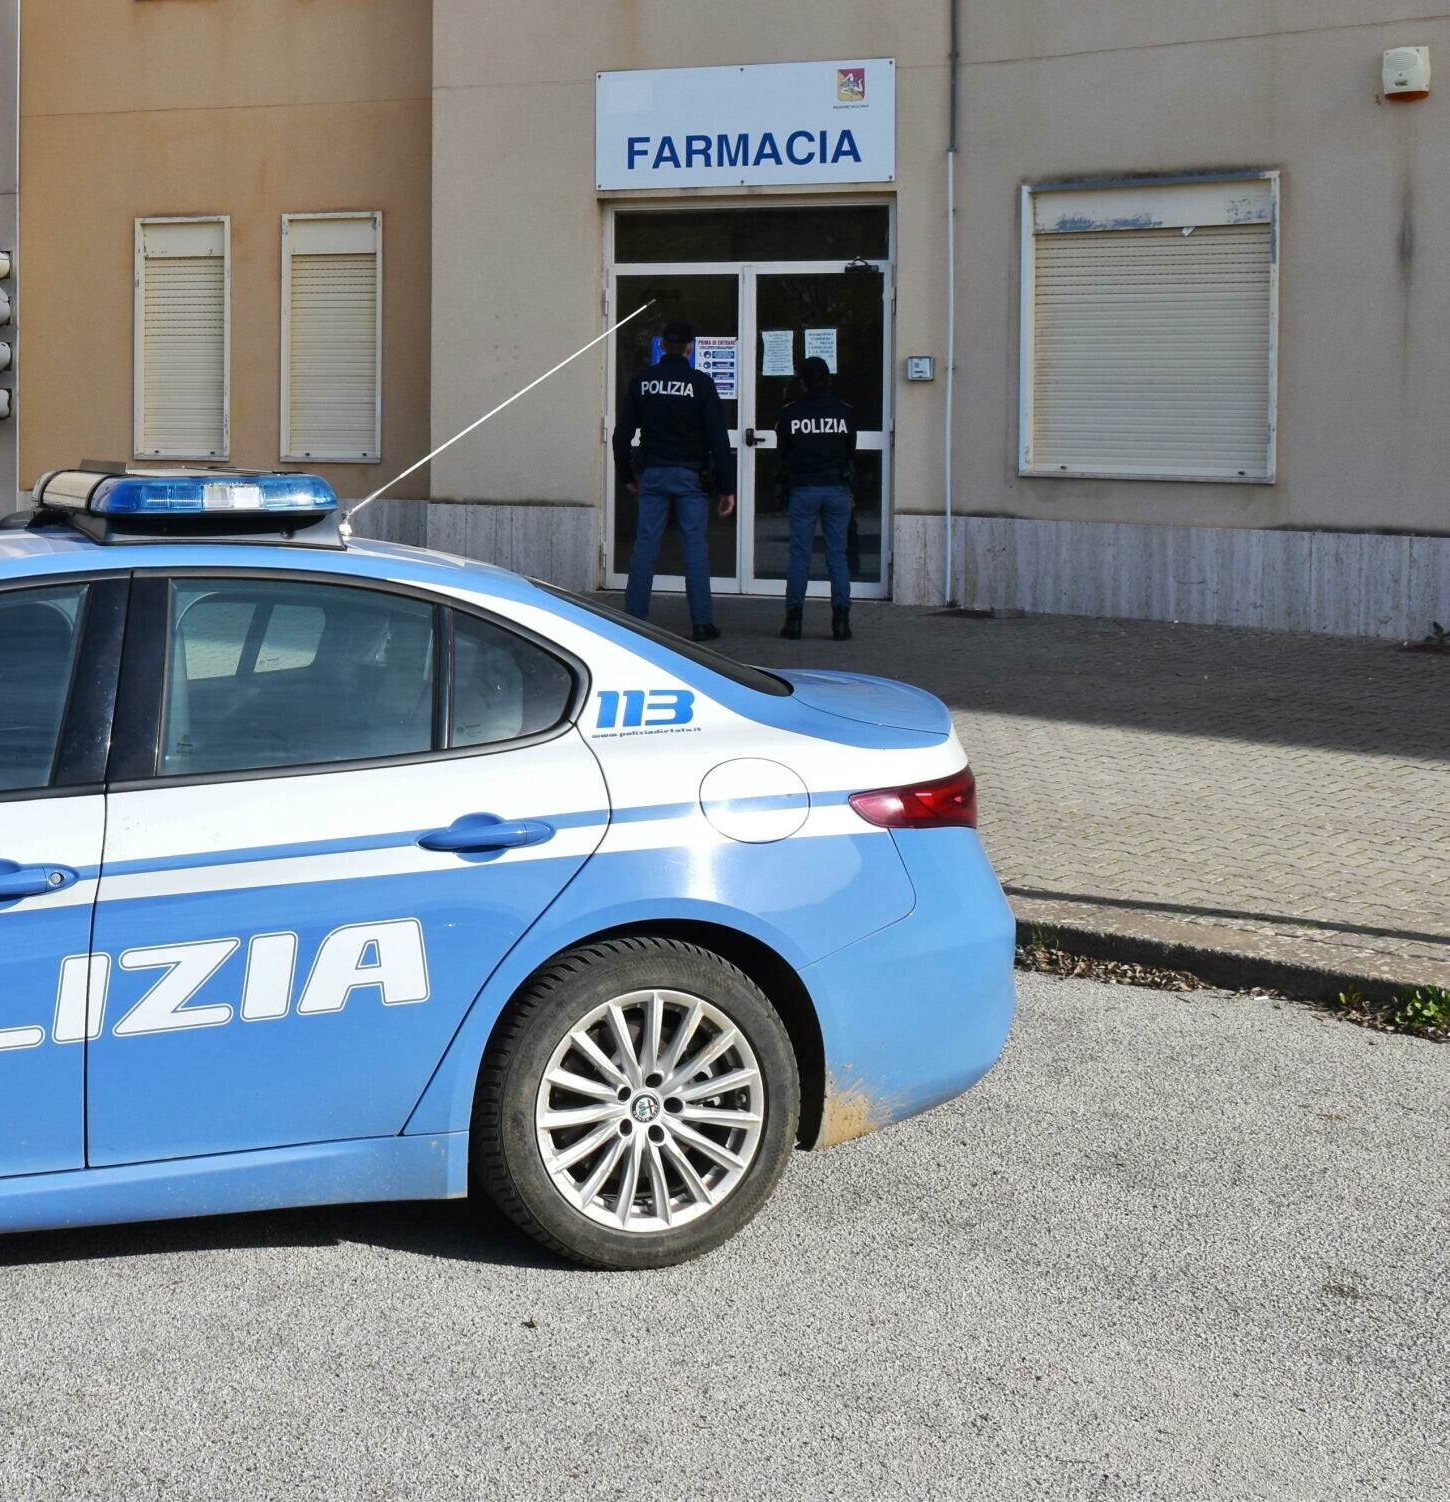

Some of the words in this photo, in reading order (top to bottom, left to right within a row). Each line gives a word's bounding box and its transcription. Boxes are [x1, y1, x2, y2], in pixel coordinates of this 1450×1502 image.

[626, 129, 862, 170] FARMACIA
[640, 379, 695, 398] POLIZIA
[790, 418, 848, 435] POLIZIA
[596, 690, 695, 728] 113
